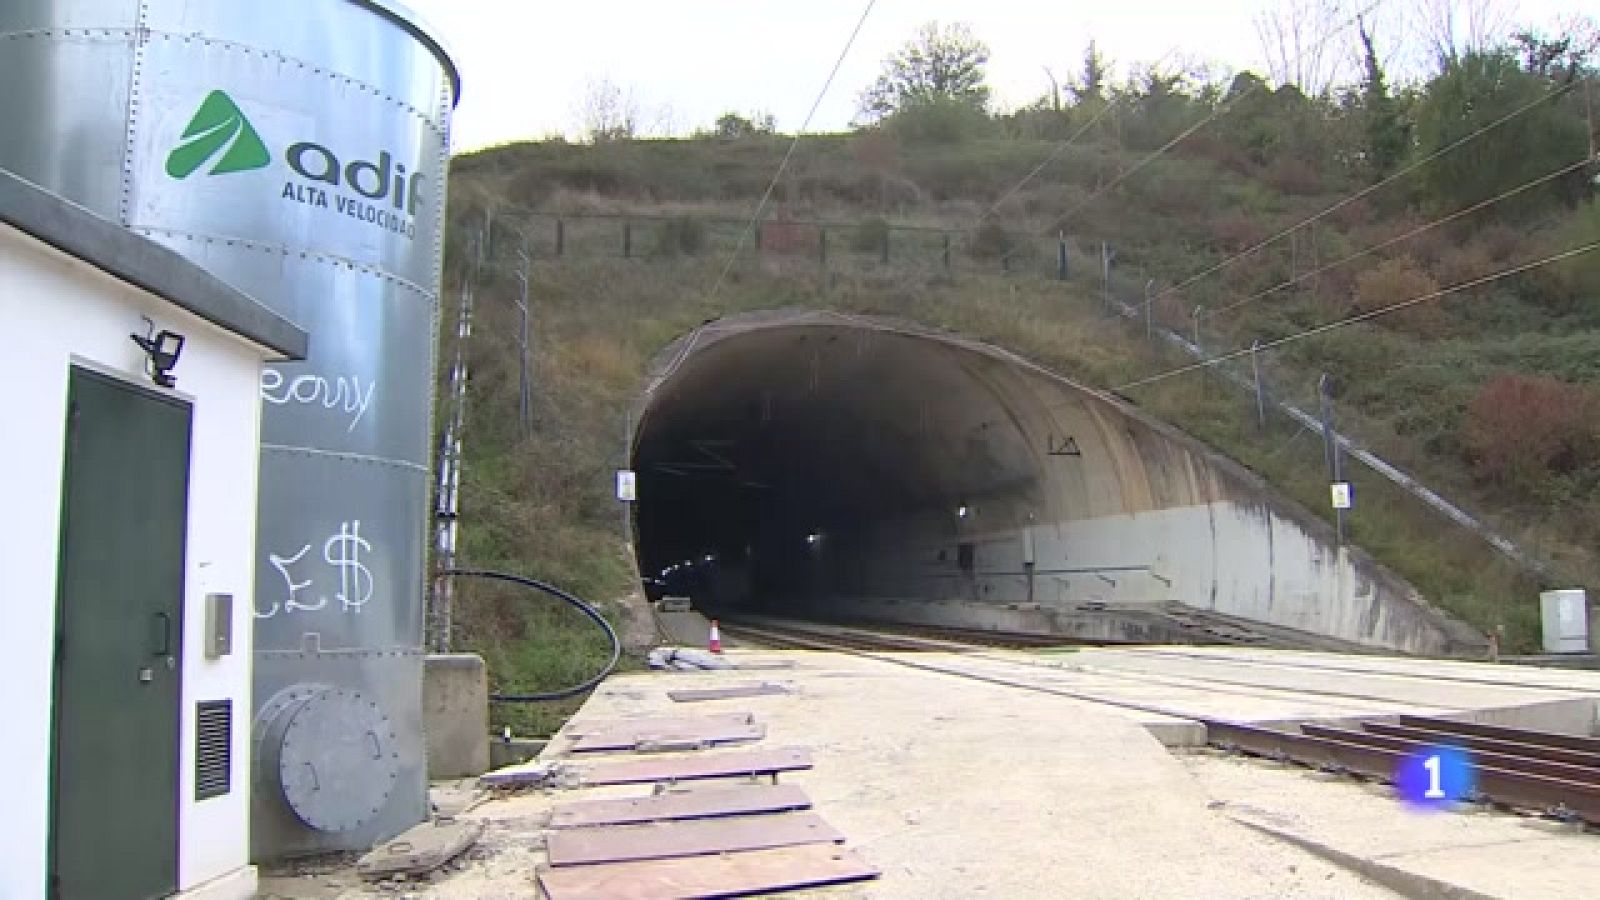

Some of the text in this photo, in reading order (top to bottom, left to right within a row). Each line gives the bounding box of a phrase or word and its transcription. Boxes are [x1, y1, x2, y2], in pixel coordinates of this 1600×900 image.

[282, 182, 416, 240] ALTA VELOCIDAD
[286, 142, 425, 215] adif
